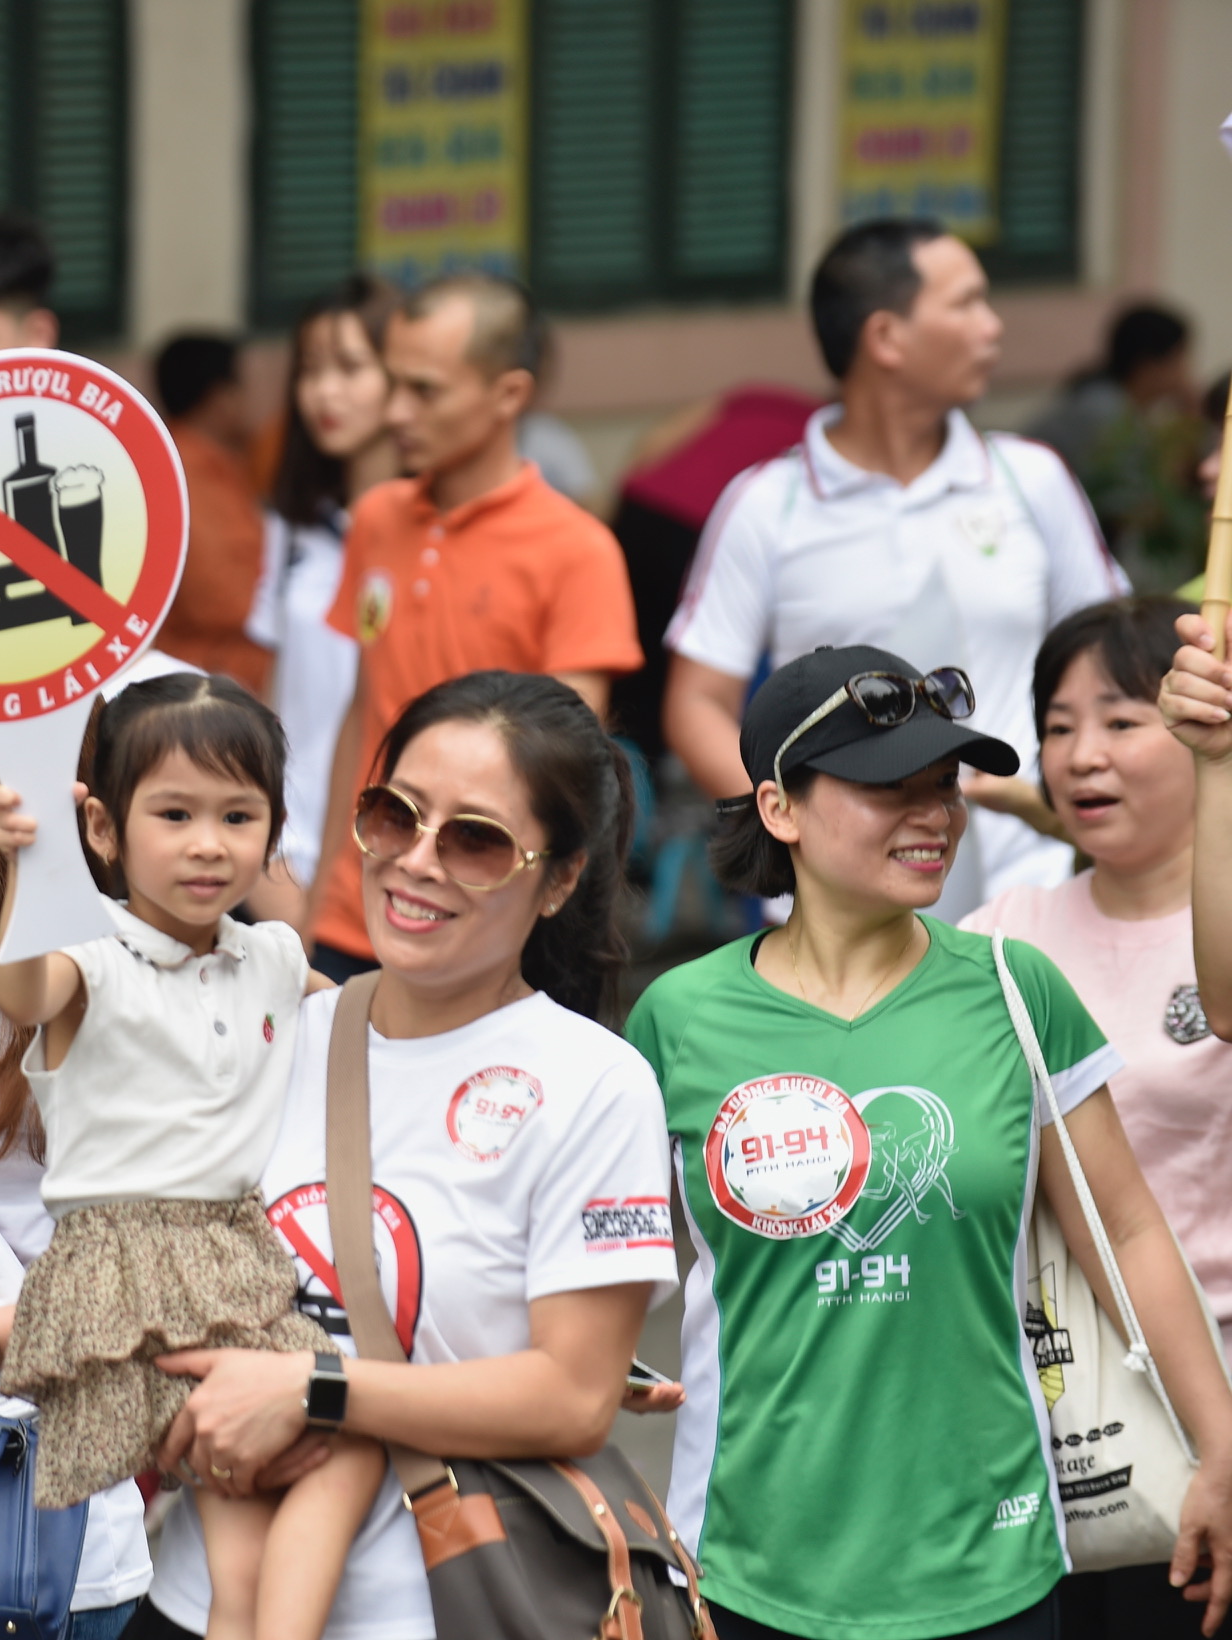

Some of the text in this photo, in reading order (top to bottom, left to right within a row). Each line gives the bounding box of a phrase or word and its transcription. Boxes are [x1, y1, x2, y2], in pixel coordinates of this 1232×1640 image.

[78, 381, 123, 425] BIA
[38, 661, 101, 710] LÁI
[105, 613, 150, 662] XE
[741, 1125, 829, 1164] 91-94
[746, 1155, 832, 1178] PTTH HANOI
[752, 1215, 804, 1236] KHÔNG
[825, 1201, 845, 1223] XE
[815, 1254, 911, 1293] 91-94
[817, 1290, 910, 1307] PTTH HANOI
[1065, 1499, 1130, 1524] athon.com
